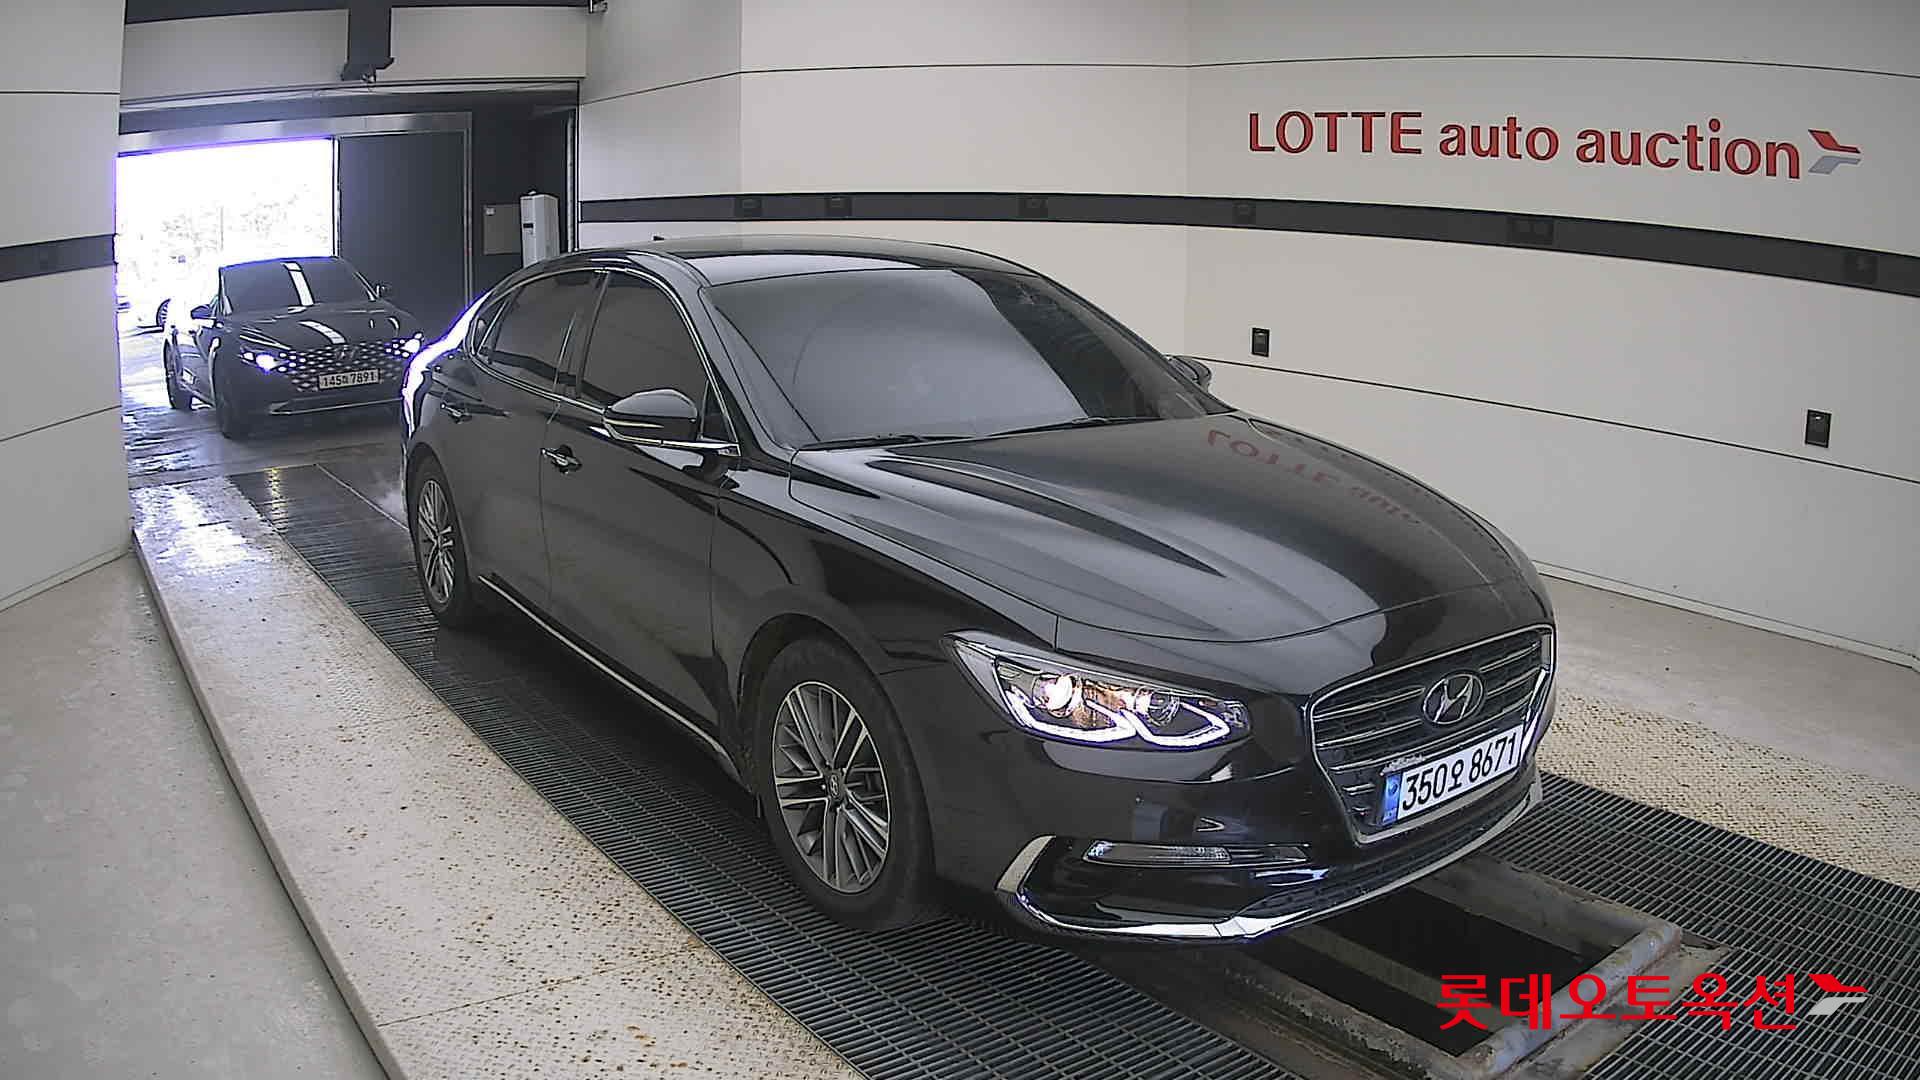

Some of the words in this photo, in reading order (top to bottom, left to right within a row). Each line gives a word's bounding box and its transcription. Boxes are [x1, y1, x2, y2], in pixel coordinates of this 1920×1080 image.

[1249, 111, 1423, 155] LOTTE
[1439, 116, 1560, 162] auto
[1576, 118, 1801, 180] auction
[350, 371, 375, 384] 7891
[1402, 759, 1465, 811] 350오
[1468, 732, 1517, 783] 8671
